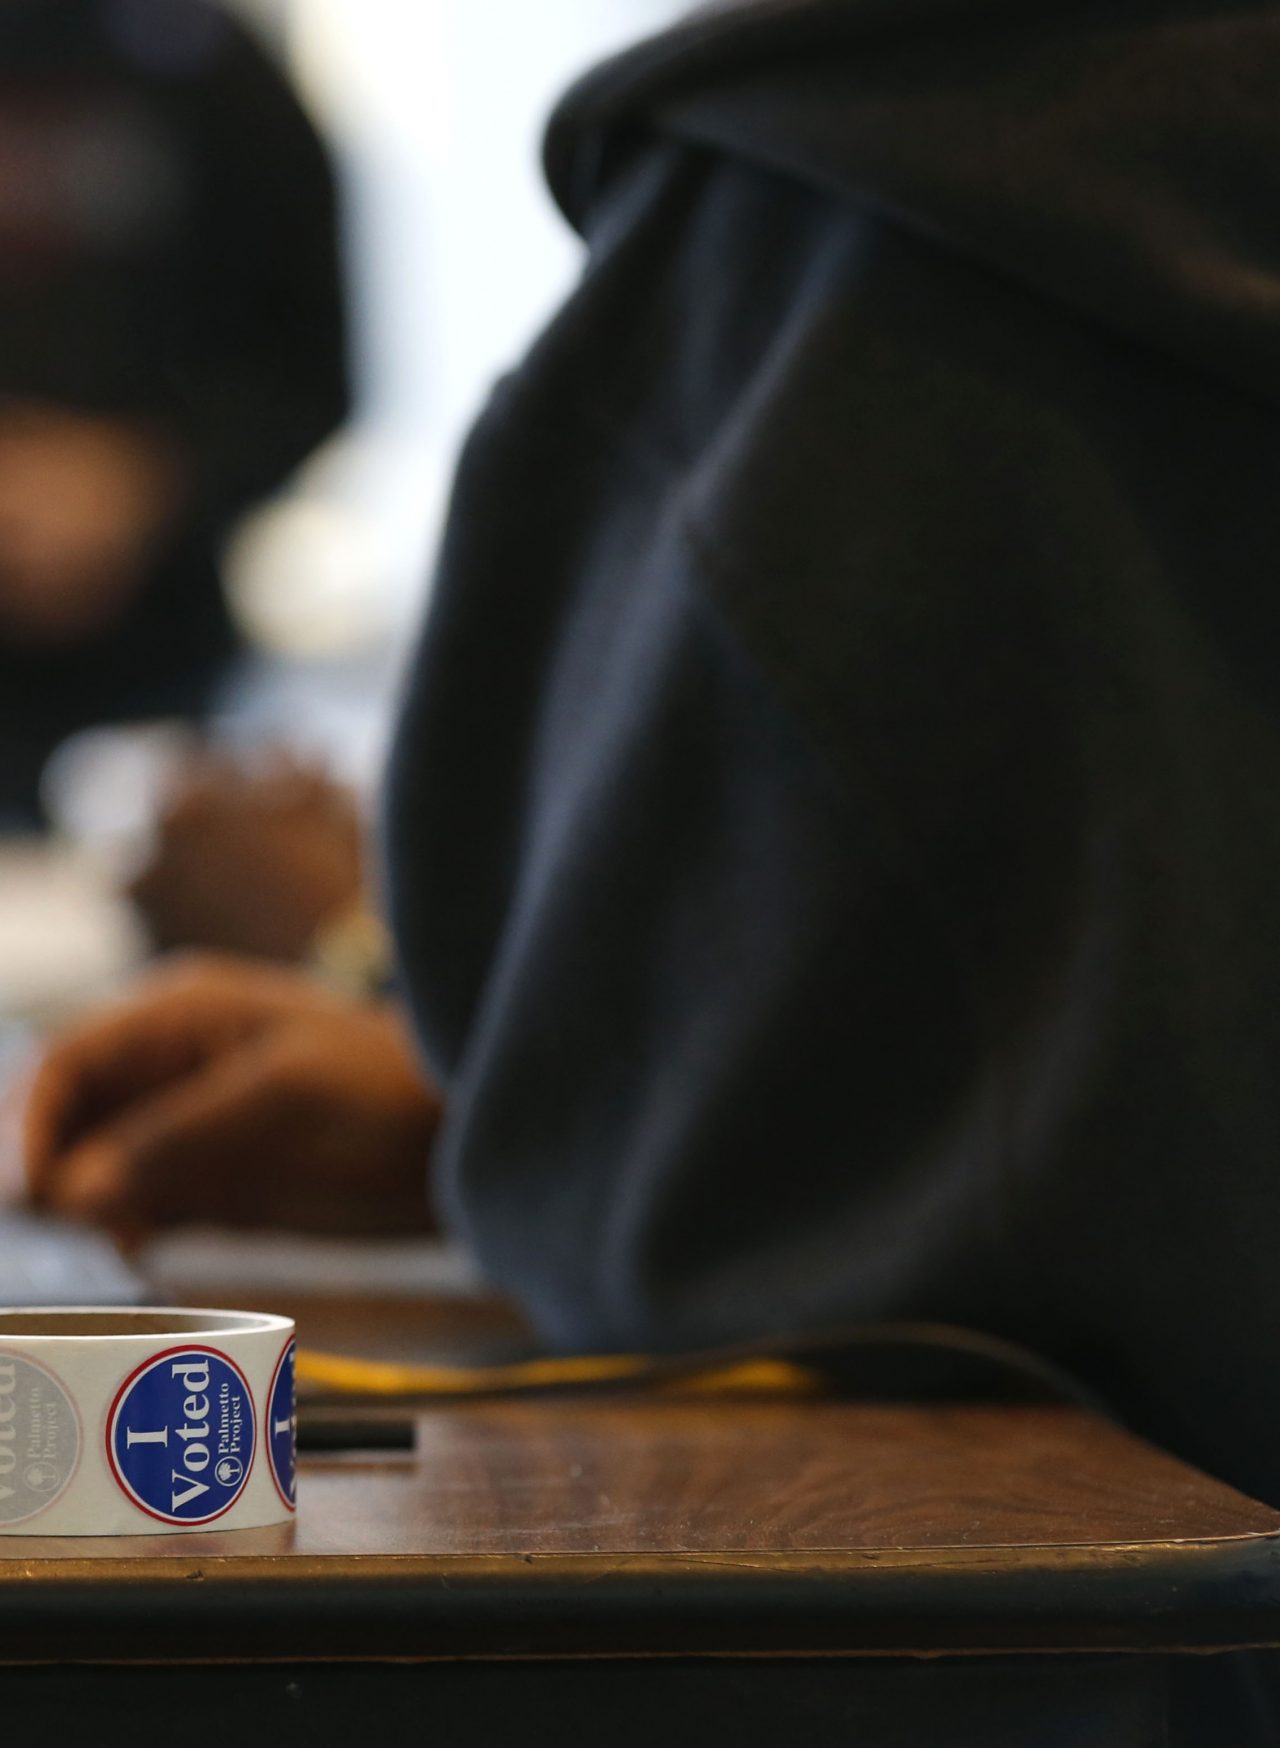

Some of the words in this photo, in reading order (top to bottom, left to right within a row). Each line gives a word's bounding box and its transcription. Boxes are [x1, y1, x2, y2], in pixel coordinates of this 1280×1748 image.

[28, 1387, 41, 1459] Palmetto
[43, 1401, 60, 1459] Project
[126, 1425, 168, 1450] I
[171, 1359, 211, 1513] Voted
[218, 1382, 230, 1454] Palmetto
[230, 1396, 244, 1454] Project
[275, 1416, 290, 1439] I
